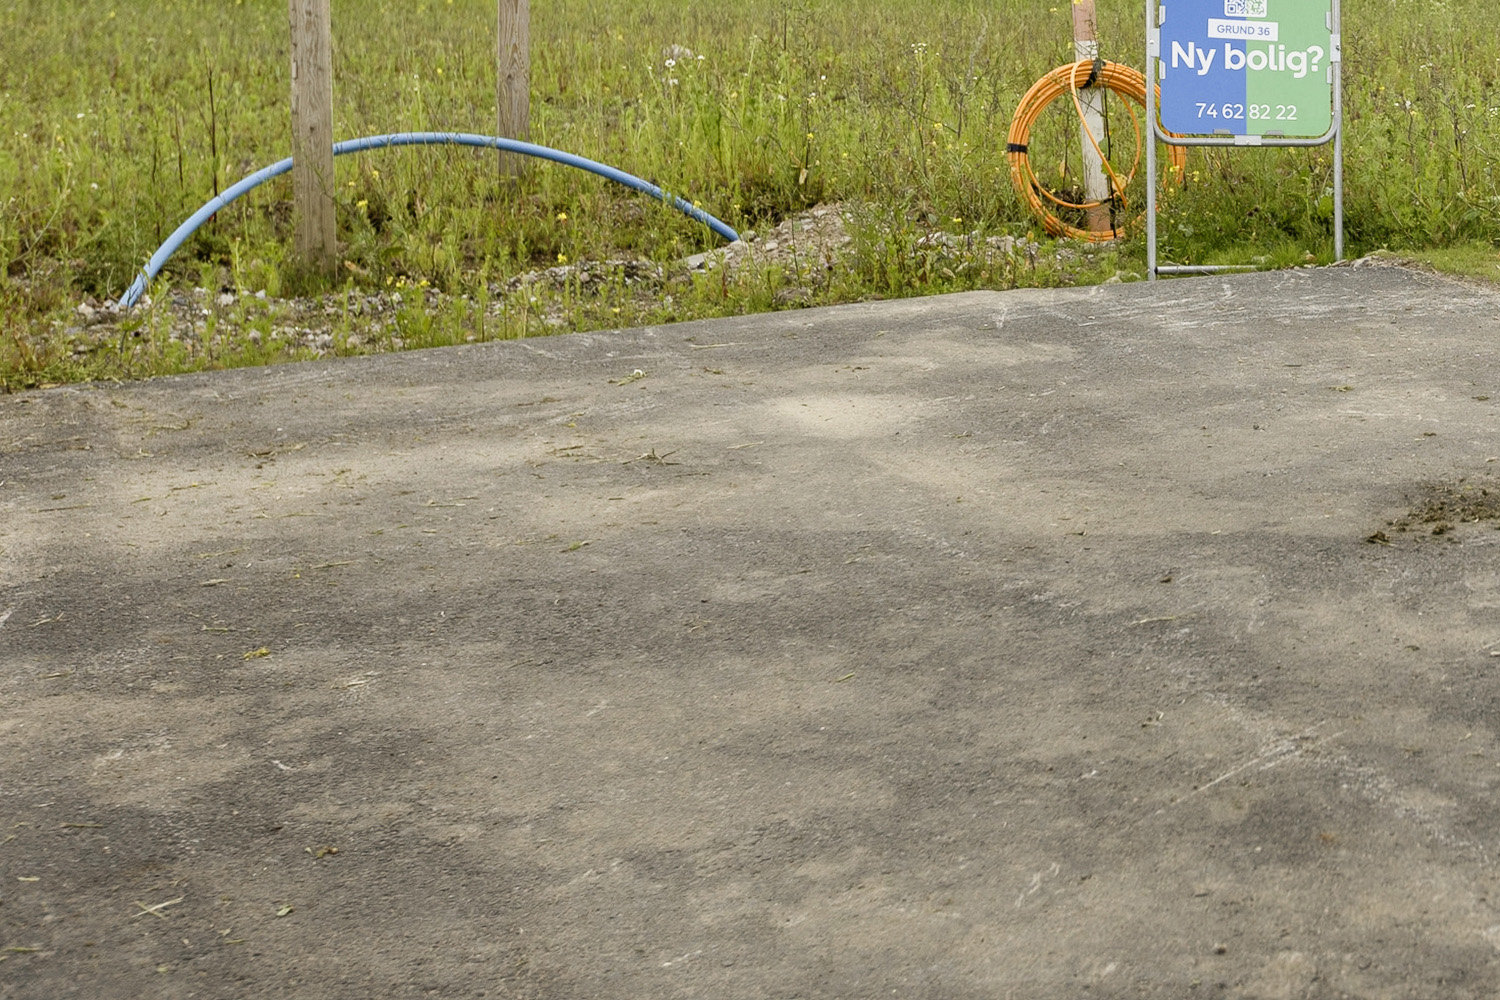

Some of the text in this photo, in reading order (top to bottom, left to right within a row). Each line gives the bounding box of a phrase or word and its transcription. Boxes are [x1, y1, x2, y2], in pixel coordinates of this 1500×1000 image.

[1216, 24, 1271, 36] GRUND 36
[1171, 40, 1324, 79] Ny bolig?
[1195, 102, 1298, 120] 74 62 82 22
